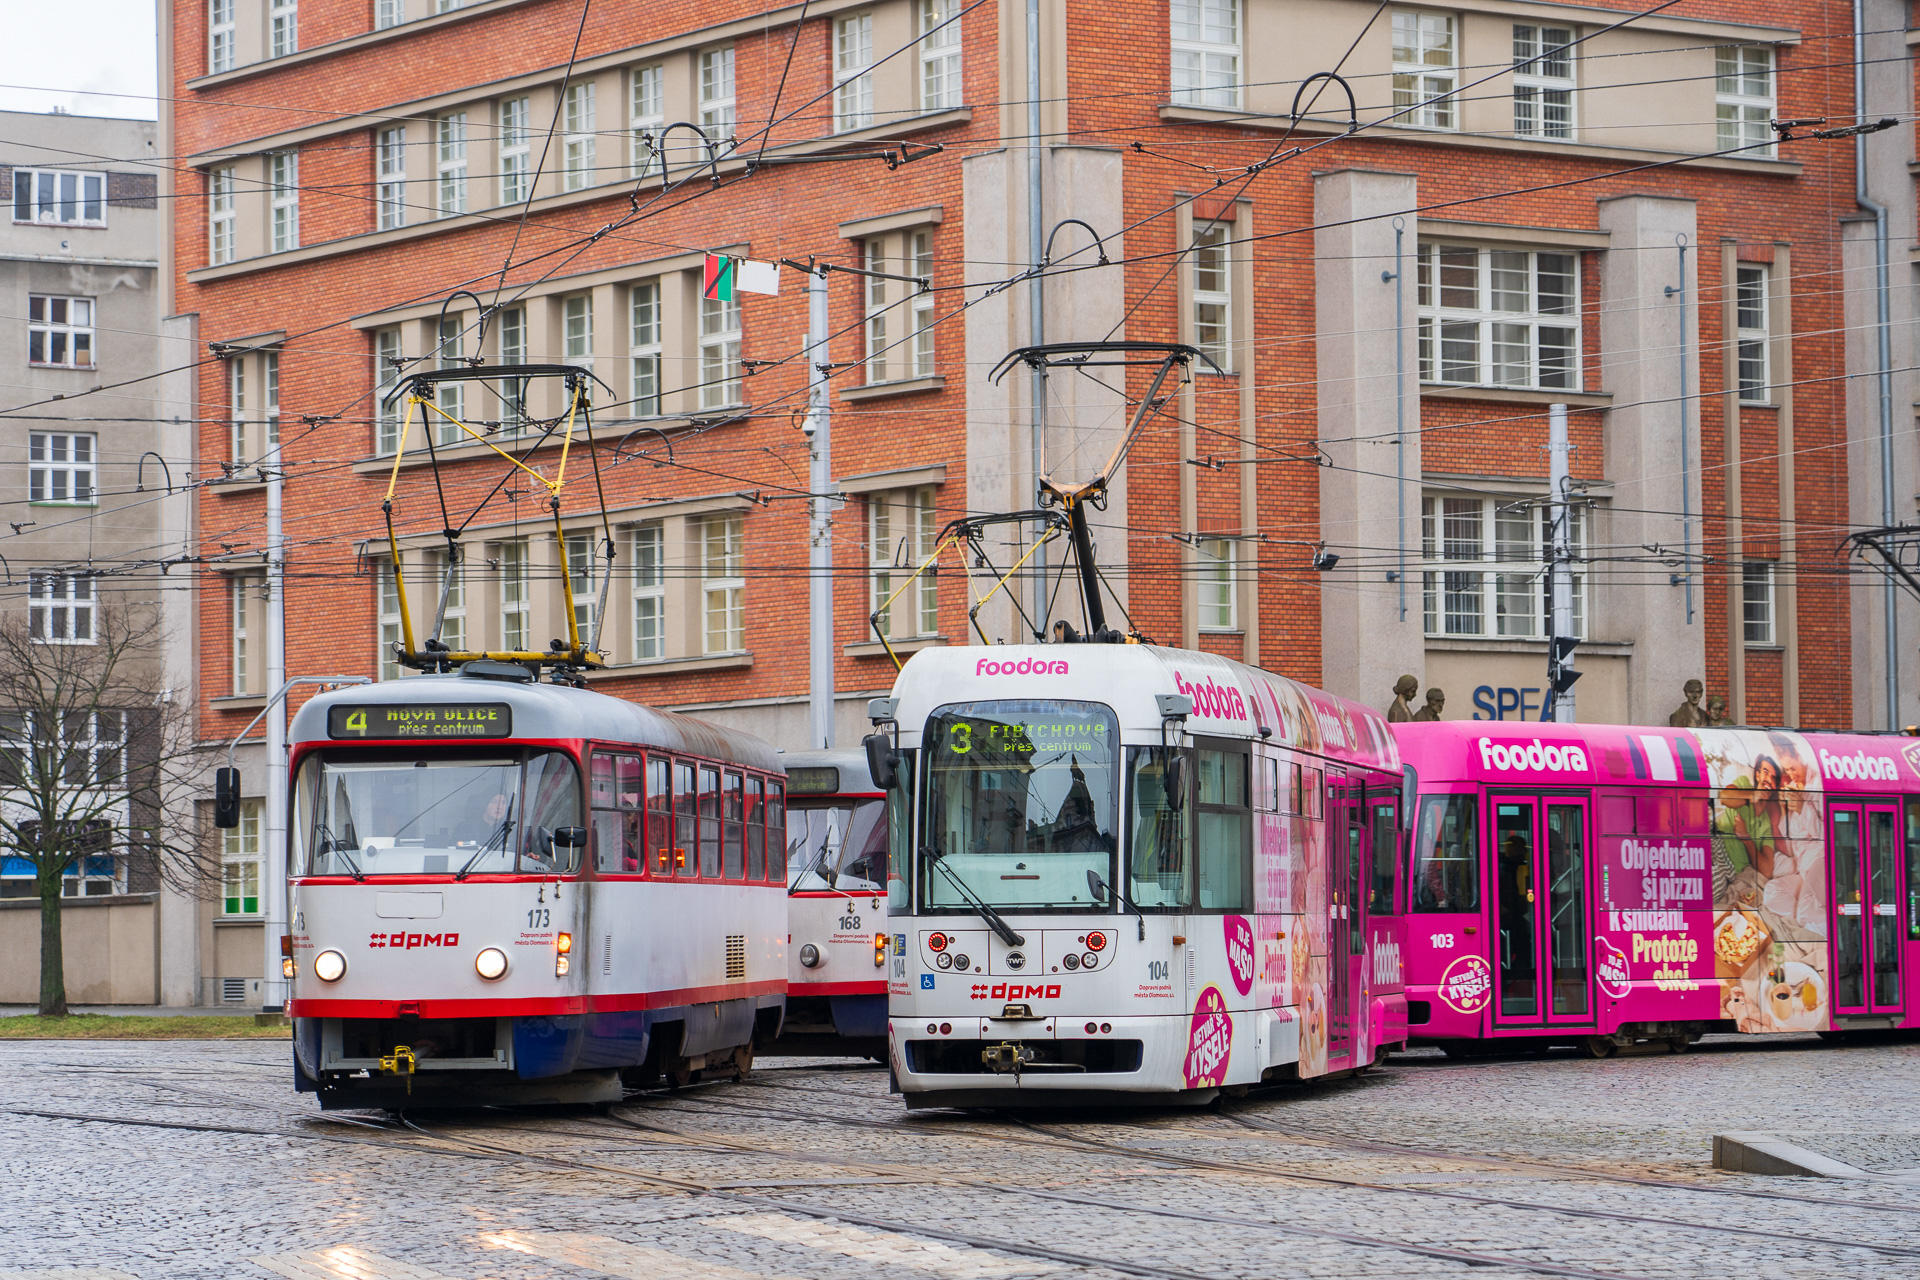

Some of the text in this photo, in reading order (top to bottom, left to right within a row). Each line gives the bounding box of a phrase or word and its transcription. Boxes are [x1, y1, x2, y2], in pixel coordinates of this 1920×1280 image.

[976, 657, 1069, 676] foodora
[1174, 670, 1247, 721] foodora
[346, 708, 368, 737] 4
[398, 721, 485, 736] přes centrum
[950, 722, 1105, 754] 3 FIBICHOVA
[1040, 740, 1092, 751] centrum
[1478, 737, 1588, 772] foodora
[1819, 748, 1899, 781] foodora
[1621, 838, 1705, 876] Objednám
[1642, 871, 1657, 900] si
[1659, 871, 1703, 907] pizzu
[527, 908, 551, 929] 173
[838, 915, 862, 930] 168
[1609, 901, 1689, 931] k snídani.
[1430, 933, 1455, 949] 103
[1632, 932, 1698, 963] Protože
[893, 958, 906, 979] 104
[1147, 960, 1169, 981] 104
[1229, 938, 1253, 982] MASO
[1448, 974, 1491, 1000] KYSELE
[1599, 963, 1627, 988] MASO
[1193, 1014, 1215, 1049] NETVAŘ
[1189, 1023, 1230, 1081] KYSELE
